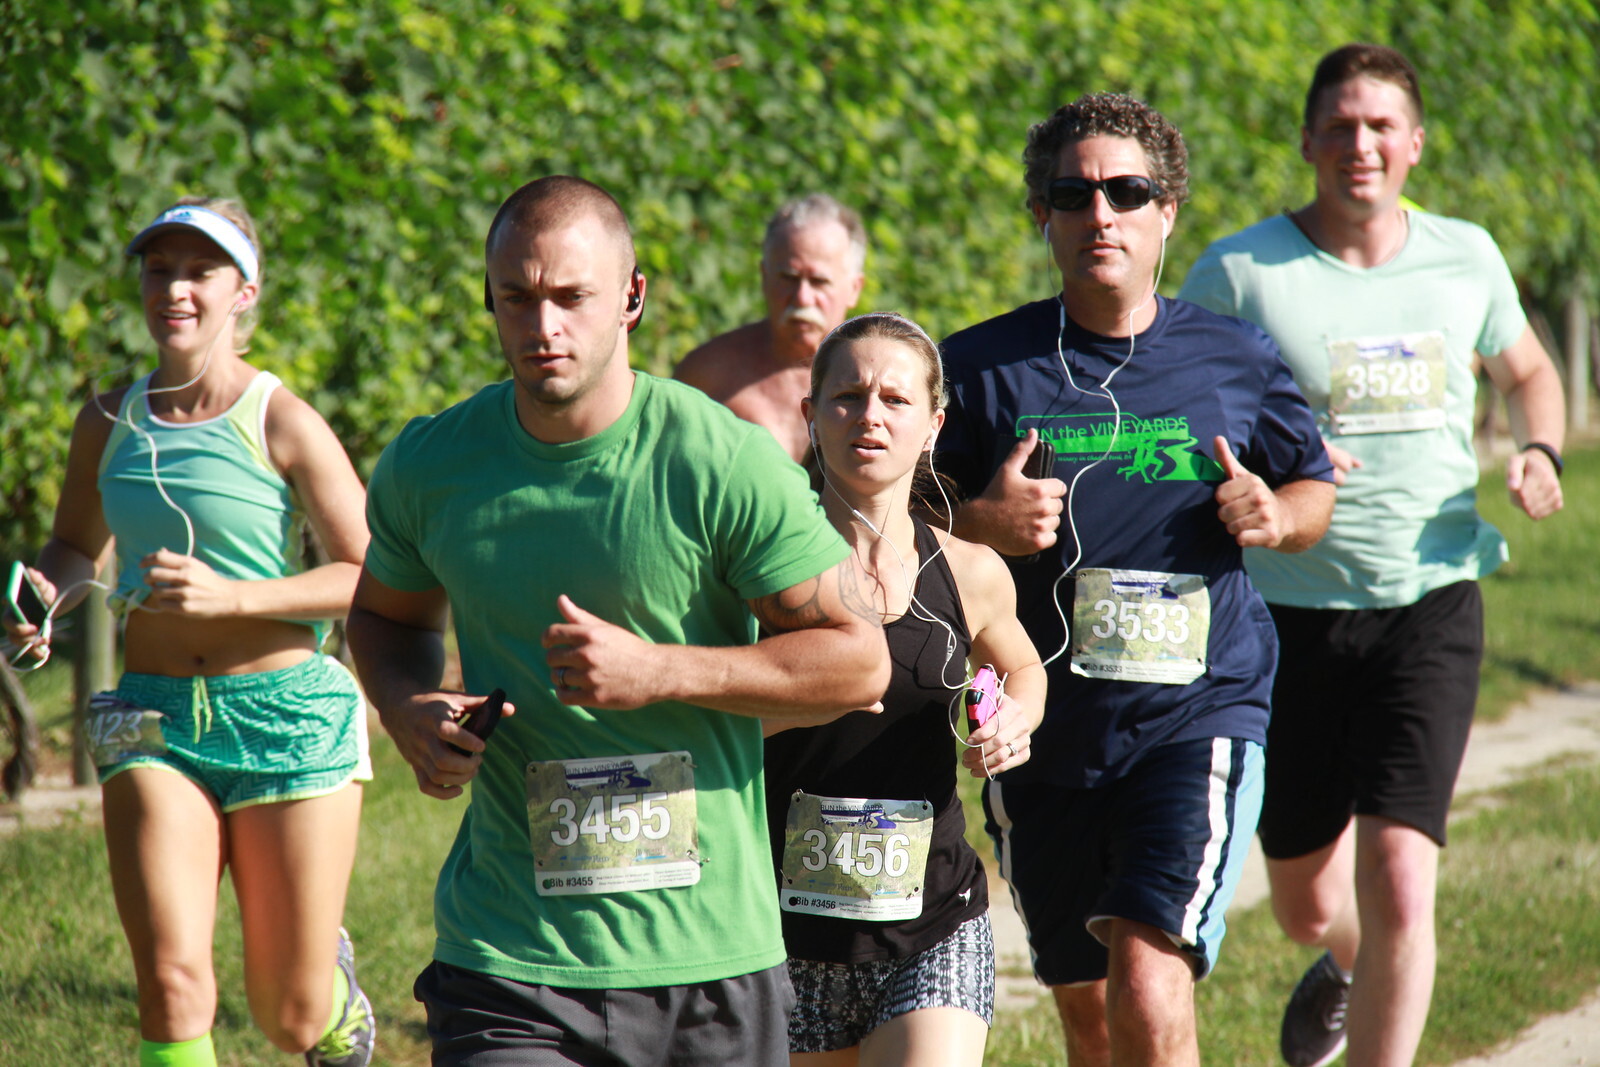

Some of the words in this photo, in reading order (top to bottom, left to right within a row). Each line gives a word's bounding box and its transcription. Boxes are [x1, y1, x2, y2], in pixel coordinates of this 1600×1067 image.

[1346, 359, 1431, 400] 3528
[1016, 427, 1054, 441] RN
[1058, 425, 1087, 439] the
[1089, 416, 1189, 437] VINEYARDS
[1091, 599, 1190, 644] 3533
[1100, 664, 1122, 673] #3533
[85, 711, 143, 747] 423
[549, 792, 671, 846] 3455
[802, 828, 911, 878] 3456
[566, 876, 593, 887] #3455
[811, 897, 836, 910] #3456
